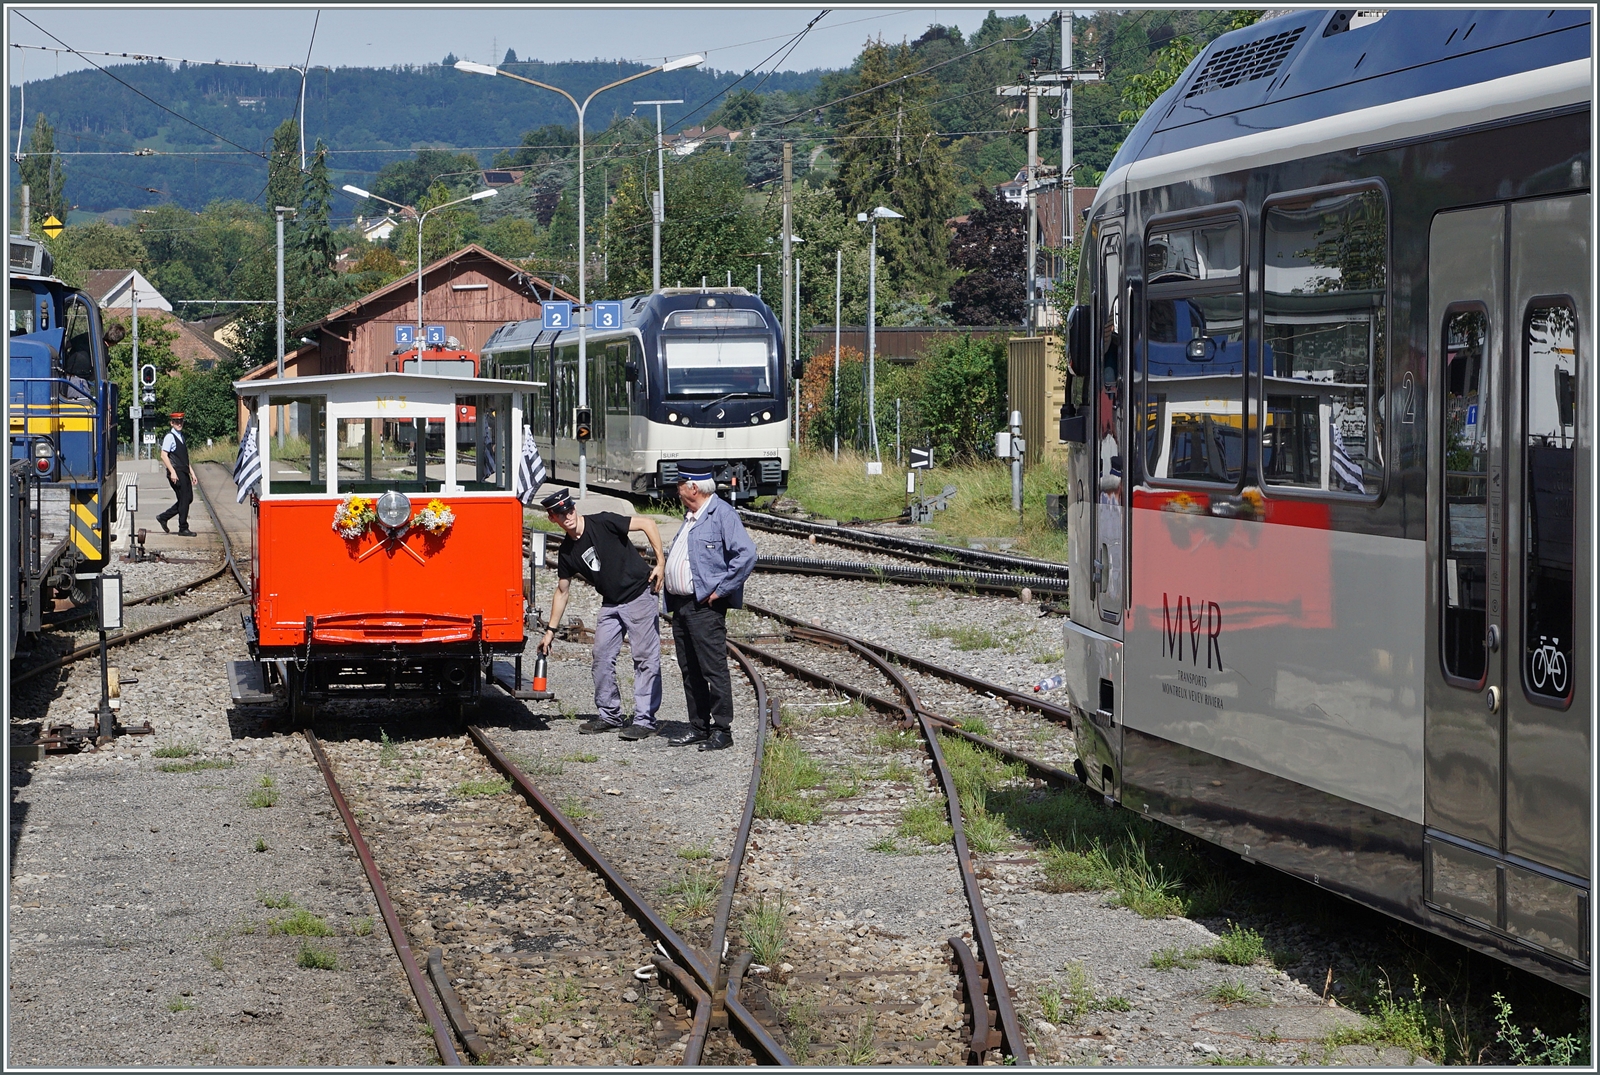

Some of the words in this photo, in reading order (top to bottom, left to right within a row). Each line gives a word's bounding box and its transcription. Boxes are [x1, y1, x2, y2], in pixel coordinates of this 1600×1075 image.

[552, 313, 562, 326] 2
[602, 313, 613, 326] 3
[401, 332, 408, 341] 2
[432, 332, 439, 341] 3
[398, 395, 407, 409] 3
[1402, 370, 1415, 424] 2
[1162, 592, 1223, 672] MVR
[1177, 669, 1208, 688] TRANSPORTS
[1161, 682, 1188, 700] MONTREUX
[1188, 689, 1204, 704] VEVEY
[1204, 694, 1224, 710] RIVIERA
